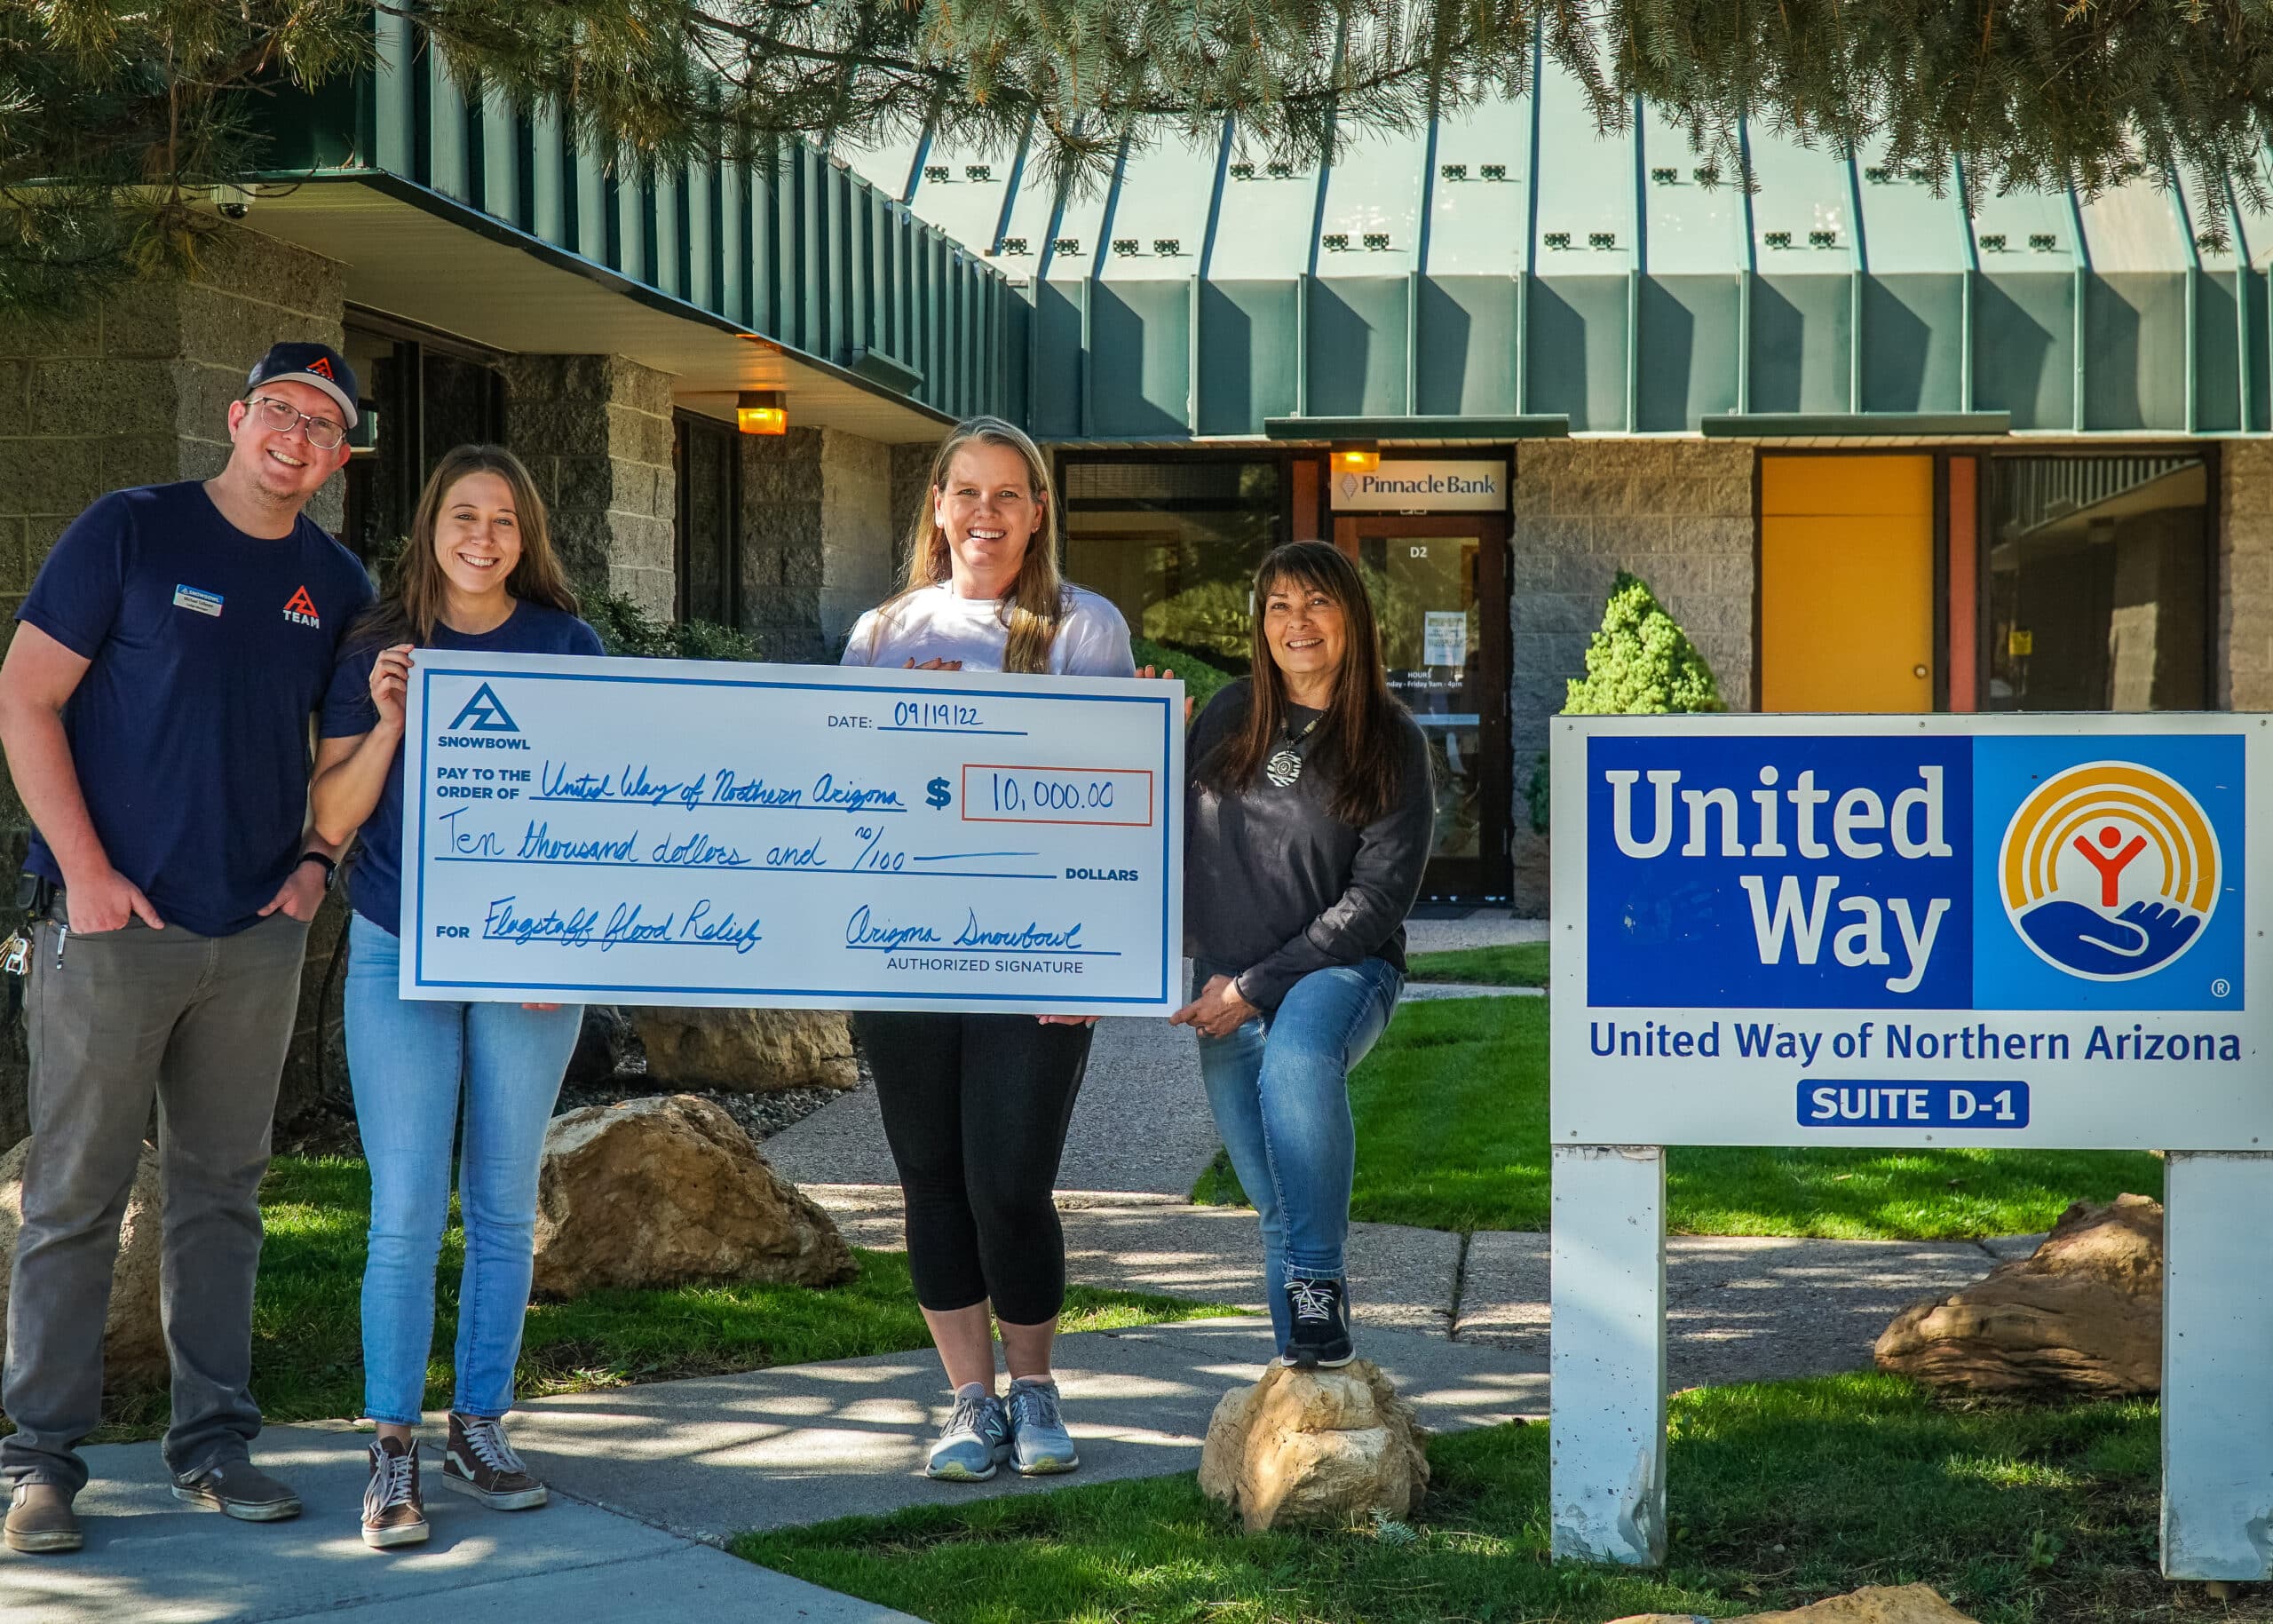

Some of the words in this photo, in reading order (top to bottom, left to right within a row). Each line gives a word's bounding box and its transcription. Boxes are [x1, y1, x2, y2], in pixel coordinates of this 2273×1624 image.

[1362, 474, 1445, 494] Pinnacle
[1447, 474, 1495, 494] Bank
[1410, 546, 1428, 558] D2
[283, 609, 320, 629] TEAM
[828, 716, 873, 729] DATE:
[438, 736, 531, 750] SNOWBOWL
[437, 767, 466, 781] PAY
[472, 768, 494, 781] TO
[499, 770, 531, 782] THE
[543, 760, 614, 800] United
[621, 764, 682, 806] Way
[681, 774, 706, 811] of
[813, 773, 904, 813] Arizona
[436, 787, 493, 799] ORDER
[498, 788, 519, 800] OF
[926, 776, 952, 810] $
[993, 772, 1113, 812] 10,000.00
[1605, 765, 1952, 859] United
[439, 806, 505, 855] Ten
[765, 836, 827, 867] and
[1065, 868, 1138, 882] DOLLARS
[436, 925, 470, 939] FOR
[483, 896, 599, 947] Flagstaff
[846, 904, 941, 954] Arizona
[1740, 875, 1952, 994] Way
[887, 957, 990, 972] AUTHORIZED
[994, 959, 1083, 974] SIGNATURE
[1589, 1021, 1720, 1057] United
[1733, 1023, 1823, 1067] Way
[1833, 1022, 1873, 1059] of
[1885, 1024, 2070, 1060] Northern
[2084, 1025, 2242, 1061] Arizona
[1810, 1089, 1929, 1121] SUITE
[1948, 1089, 2016, 1121] D-1
